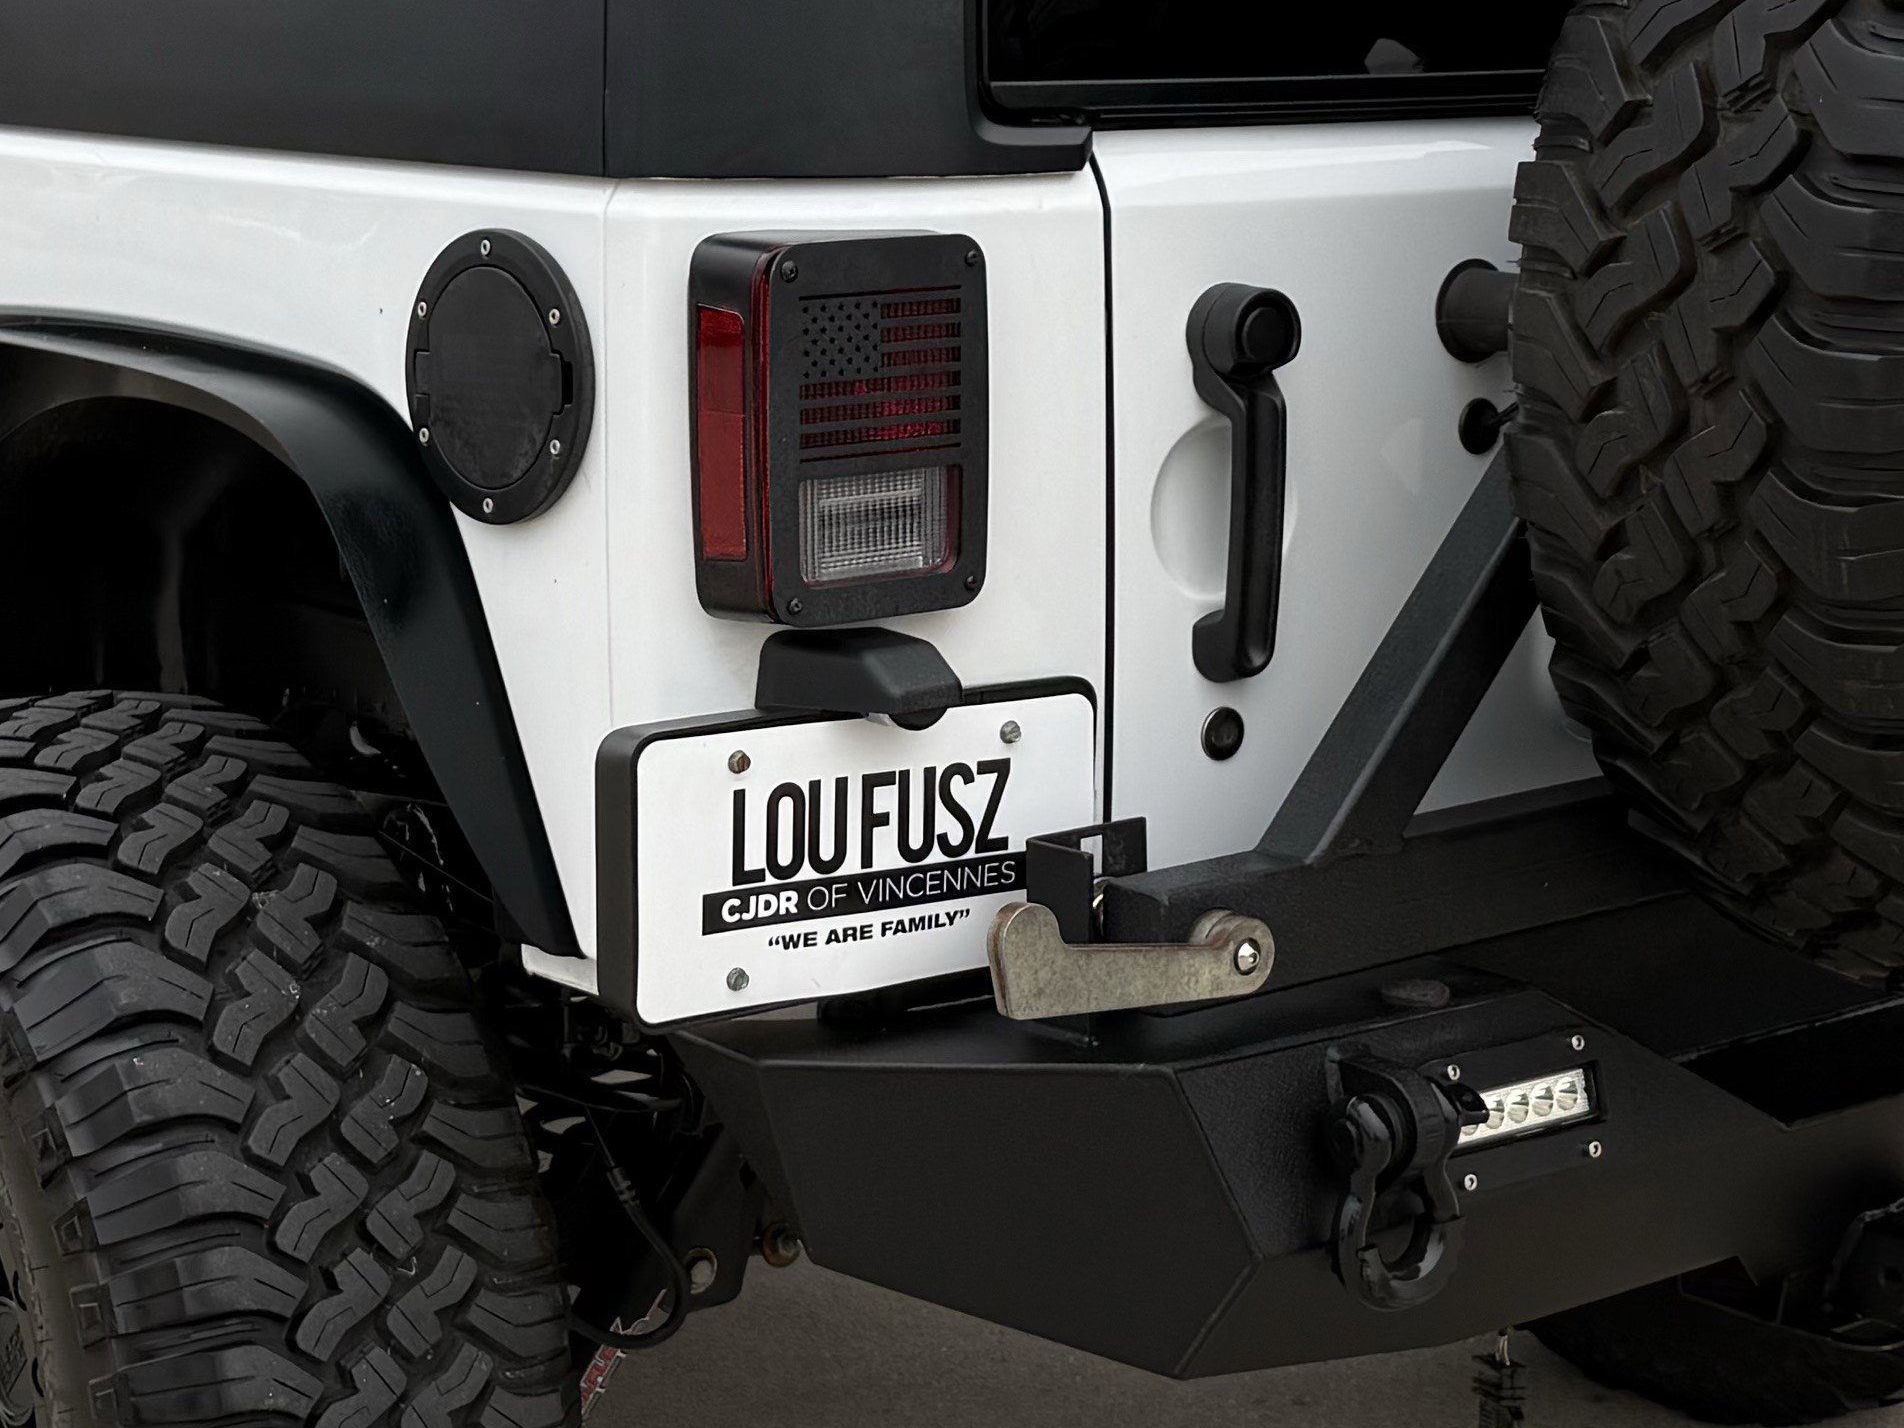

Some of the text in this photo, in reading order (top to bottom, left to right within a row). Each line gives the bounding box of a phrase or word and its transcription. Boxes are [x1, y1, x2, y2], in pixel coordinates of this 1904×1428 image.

[731, 757, 1012, 886] LOU FUSZ
[720, 860, 1016, 923] CJDR OF VINCENNES
[824, 924, 874, 945] ARE
